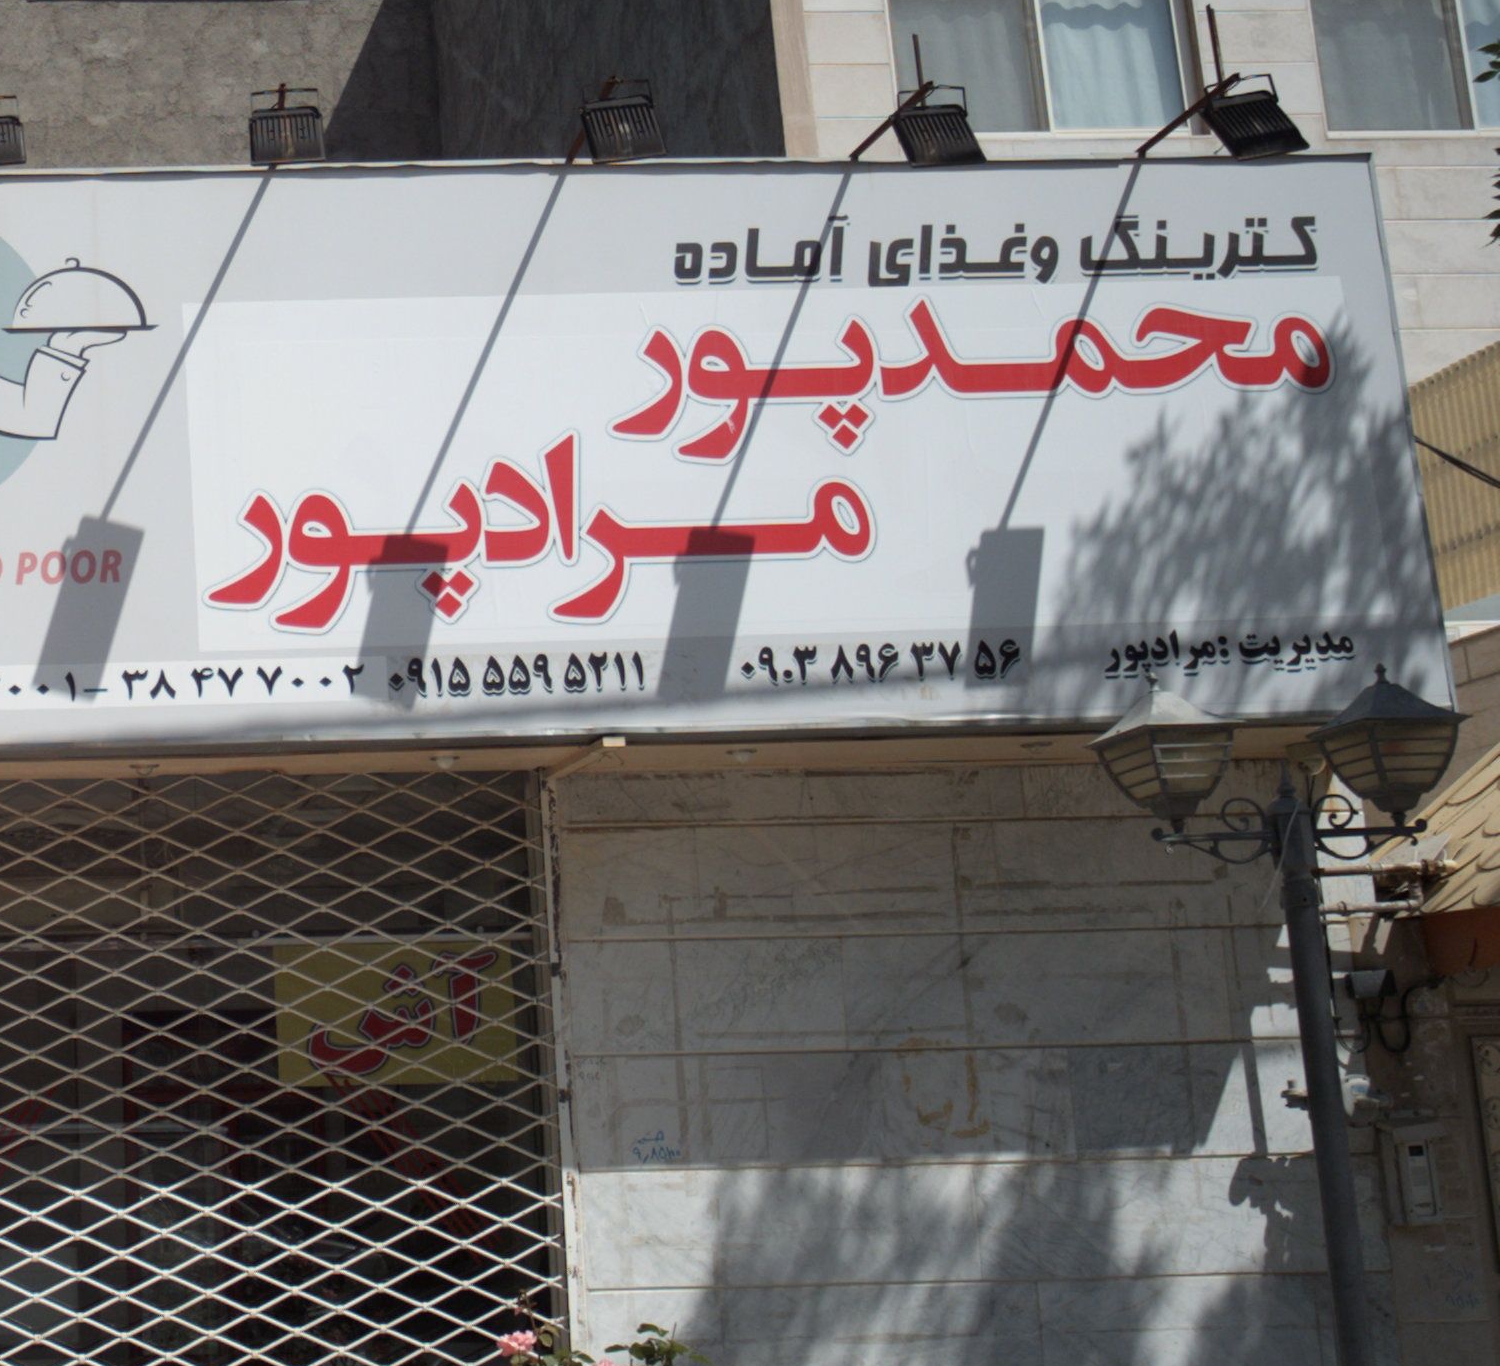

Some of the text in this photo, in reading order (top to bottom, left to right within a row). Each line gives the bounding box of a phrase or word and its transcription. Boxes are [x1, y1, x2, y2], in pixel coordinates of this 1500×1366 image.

[673, 214, 850, 285] آماده
[1079, 215, 1318, 280] کترینگ
[611, 297, 1334, 461] محمدپور
[14, 549, 124, 586] POOR
[206, 433, 874, 631] مرادپور
[308, 952, 497, 1076] آش
